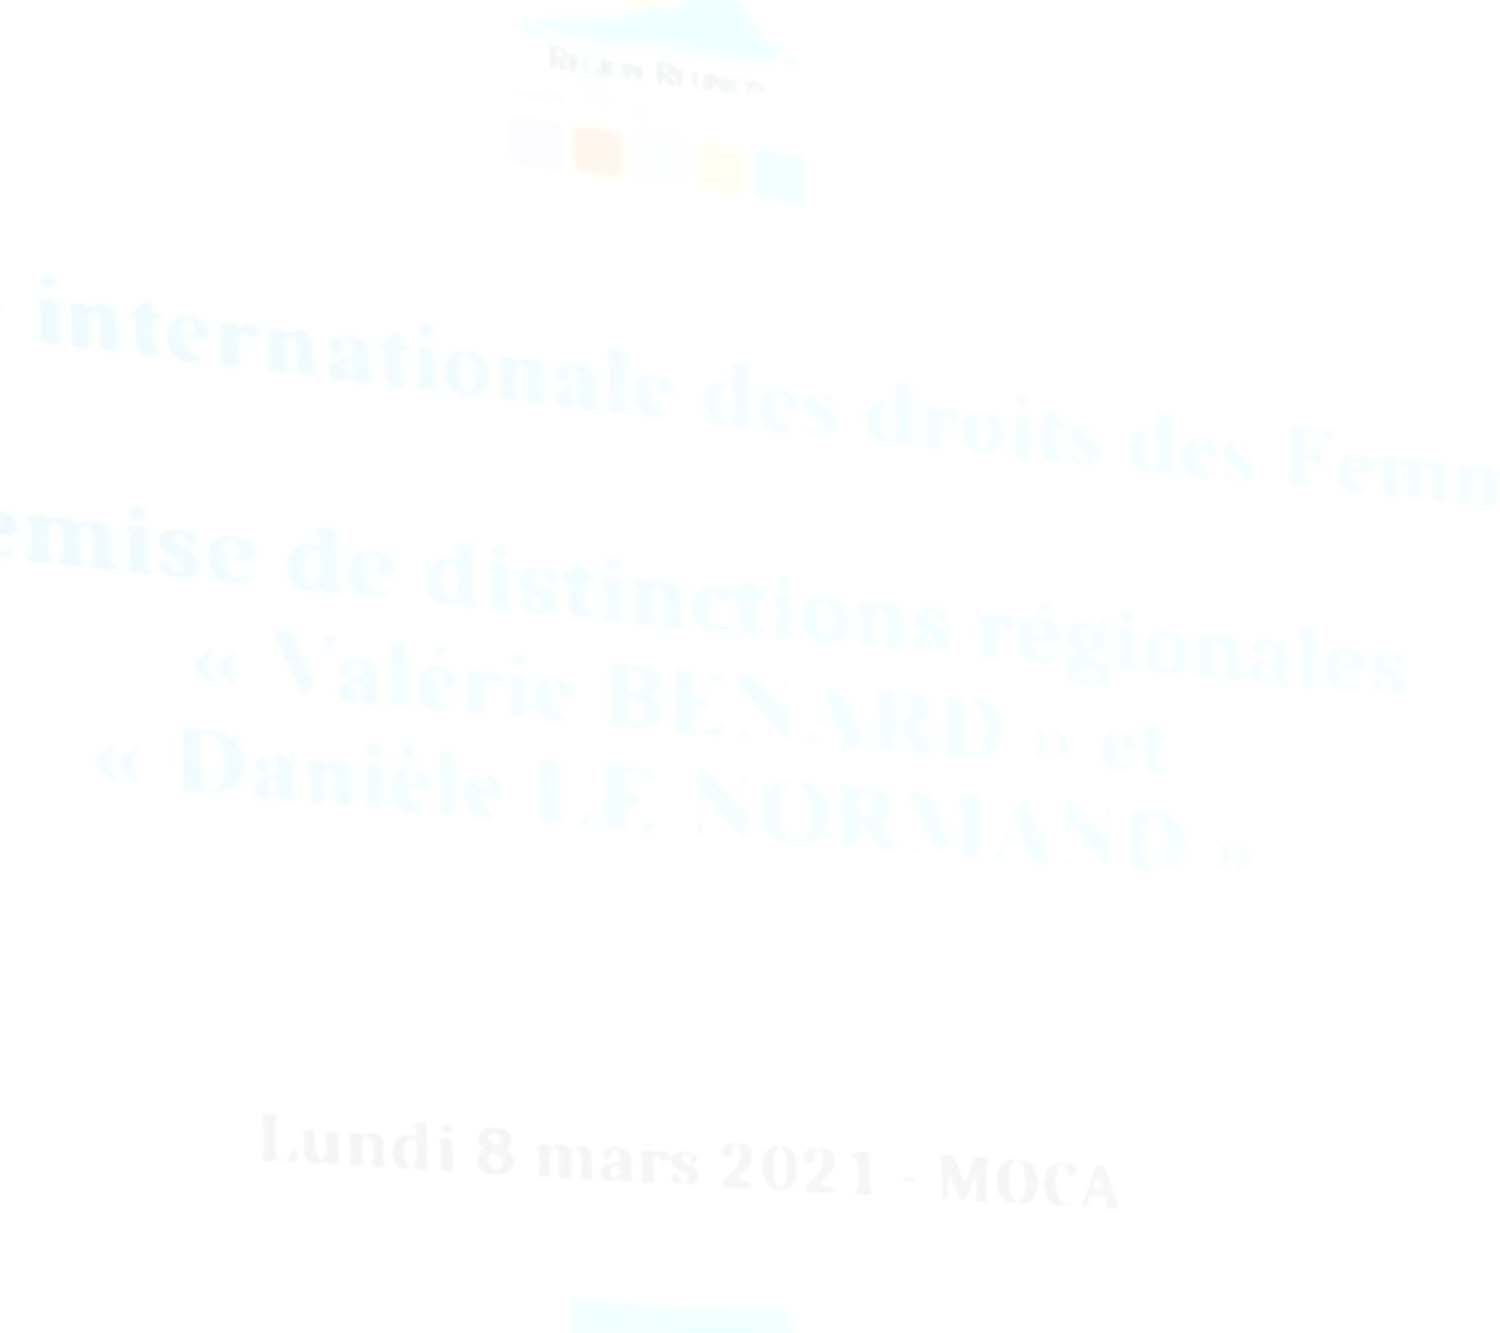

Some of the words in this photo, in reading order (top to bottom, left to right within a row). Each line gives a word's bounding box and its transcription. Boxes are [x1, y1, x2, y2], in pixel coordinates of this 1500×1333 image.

[33, 272, 673, 417] internationale
[703, 361, 838, 436] des
[865, 381, 1102, 465] droits
[1128, 411, 1256, 480] des
[287, 527, 396, 598] de
[425, 543, 951, 654] distinctions
[977, 604, 1408, 692] régionales
[273, 626, 577, 721] Valérie
[606, 661, 1004, 758] BENARD
[179, 724, 503, 819] Danièle
[696, 768, 1188, 871] NORMAND
[259, 1112, 455, 1175] Lundi
[476, 1125, 516, 1175] 8
[536, 1140, 700, 1186] mars
[719, 1141, 873, 1198] 2021
[938, 1154, 1120, 1210] MOCA
